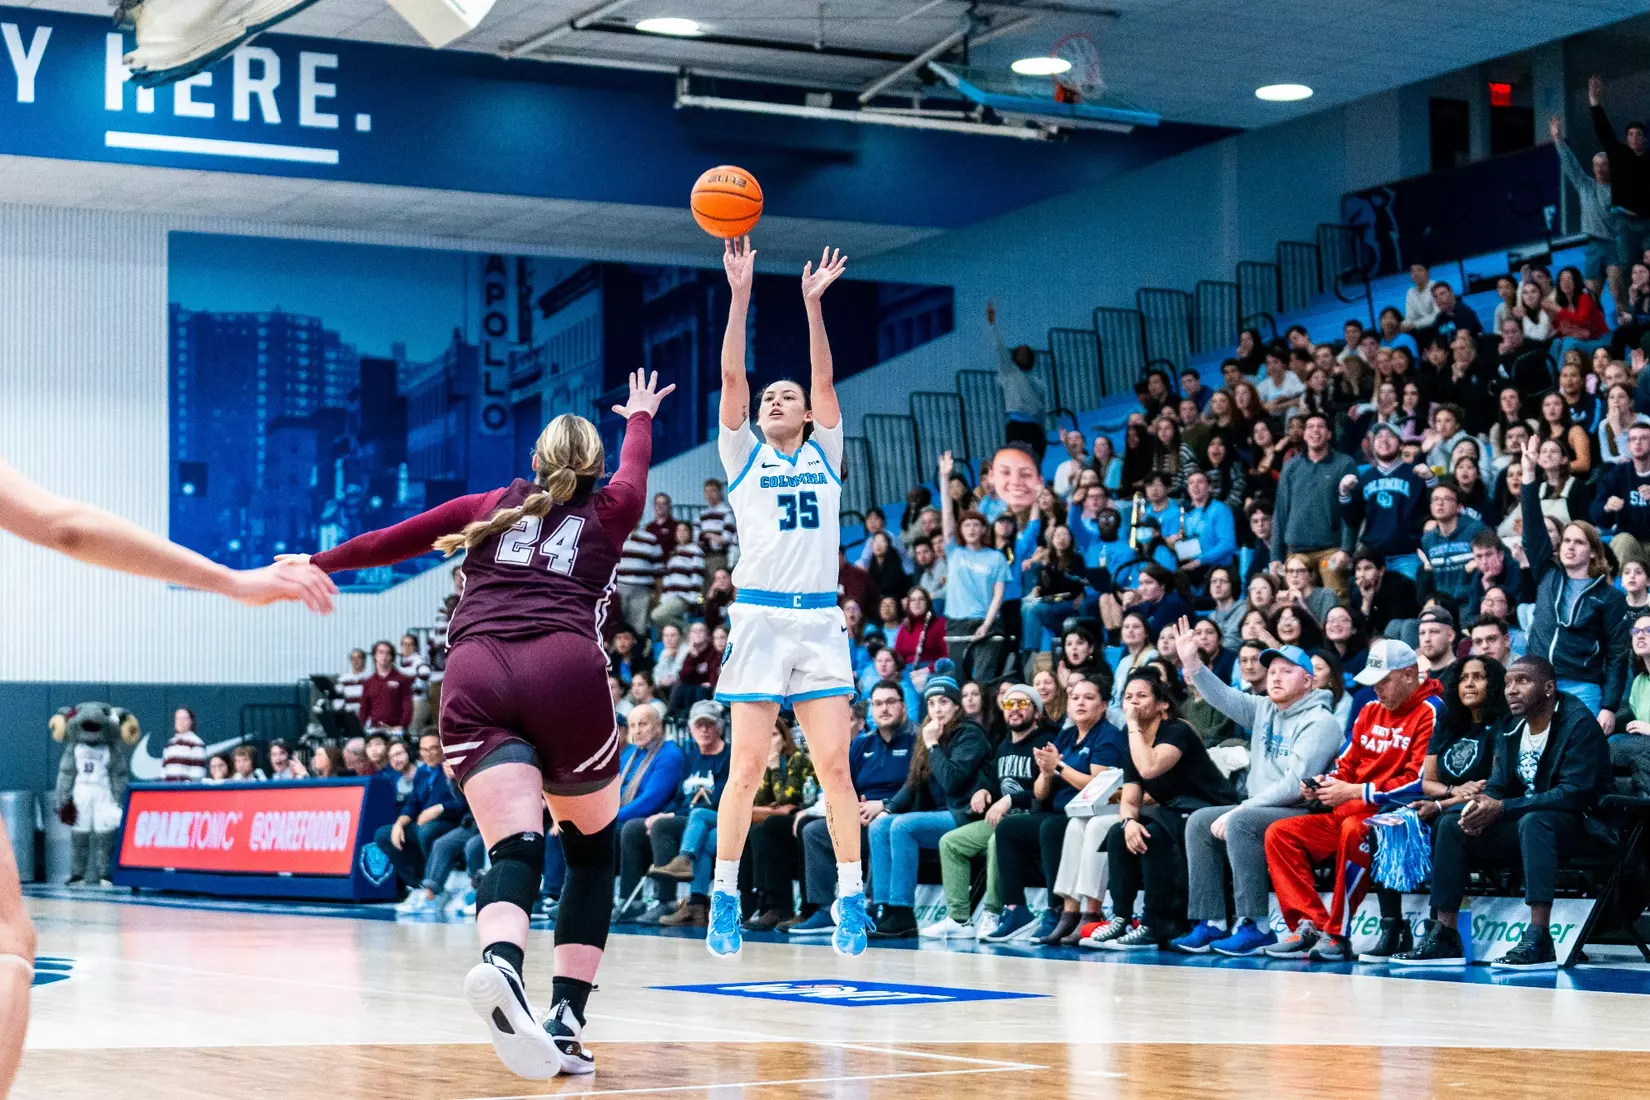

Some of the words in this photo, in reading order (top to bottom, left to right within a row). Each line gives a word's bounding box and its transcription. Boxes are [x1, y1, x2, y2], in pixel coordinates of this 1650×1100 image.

[483, 255, 508, 430] APOLLO
[776, 490, 820, 532] 35
[495, 514, 586, 577] 24
